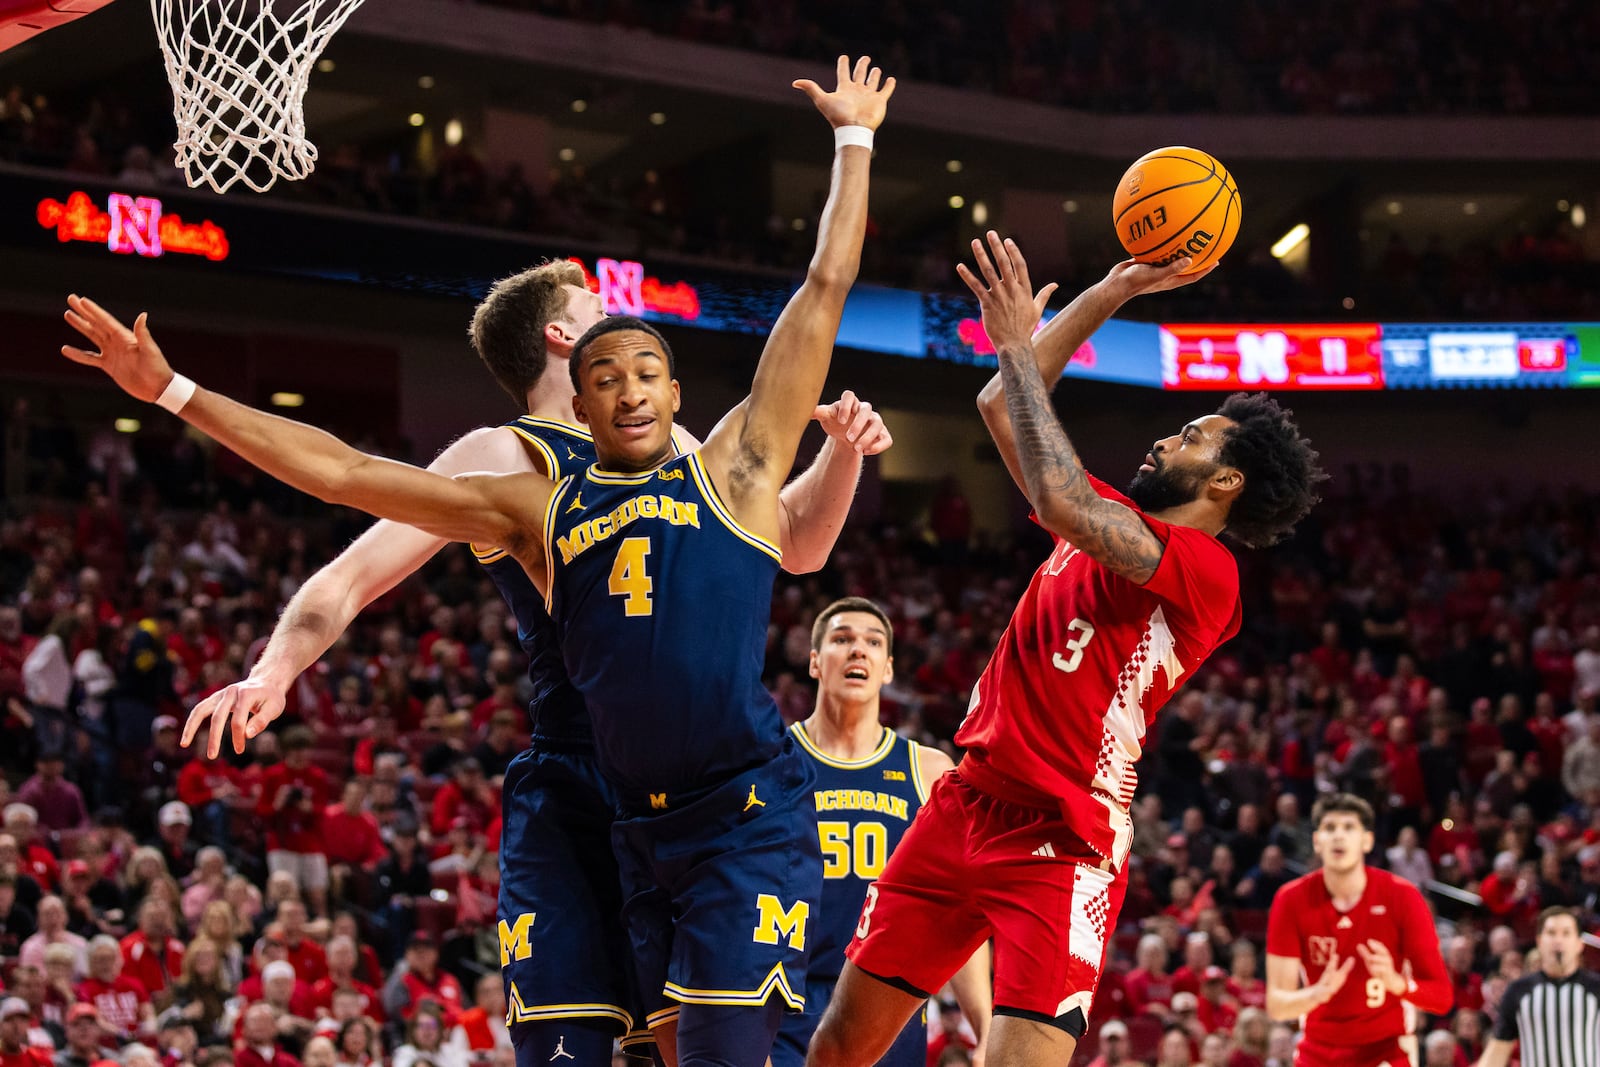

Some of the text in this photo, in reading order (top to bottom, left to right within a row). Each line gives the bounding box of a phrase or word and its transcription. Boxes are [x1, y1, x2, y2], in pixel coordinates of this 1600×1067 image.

[108, 192, 162, 257] N
[1128, 206, 1168, 242] EVO
[596, 257, 644, 317] N
[1236, 331, 1290, 384] N
[556, 494, 701, 566] MICHIGAN
[608, 536, 653, 617] 4
[1052, 617, 1095, 673] 3
[650, 792, 669, 809] M
[814, 789, 909, 821] ICHIGAN
[817, 821, 888, 879] 50
[753, 893, 809, 952] M
[856, 882, 879, 940] 3
[498, 912, 537, 969] M
[1366, 978, 1386, 1009] 9
